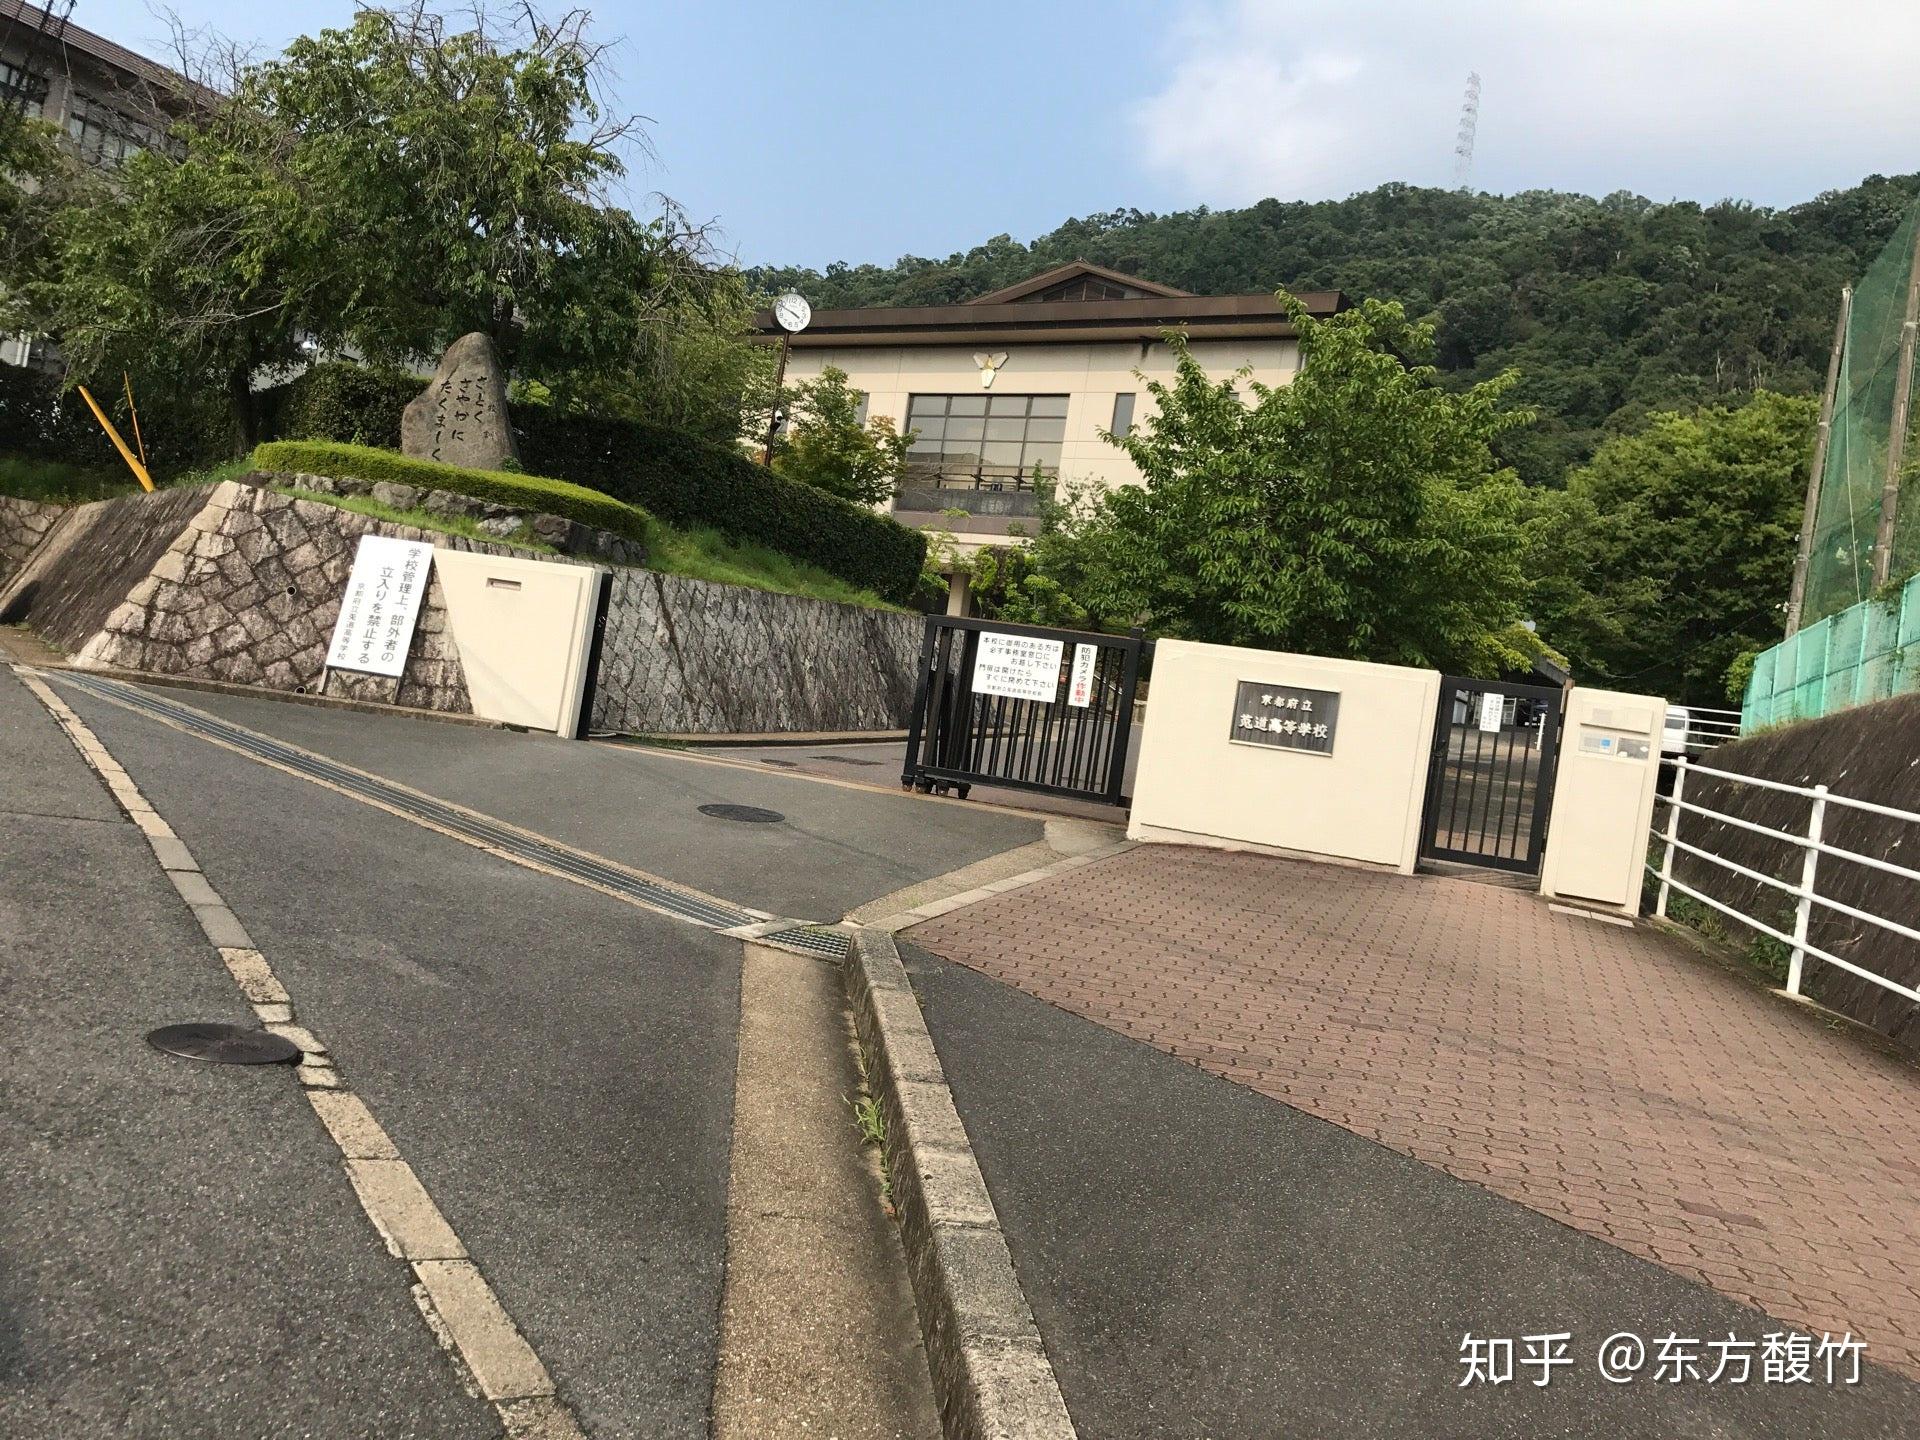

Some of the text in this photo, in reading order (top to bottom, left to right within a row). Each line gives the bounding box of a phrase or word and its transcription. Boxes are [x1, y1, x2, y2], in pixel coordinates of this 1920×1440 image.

[431, 380, 452, 461] たくましく
[451, 377, 472, 441] さやかに
[474, 375, 488, 424] さとく
[358, 565, 395, 664] 立入りを禁止する
[381, 547, 422, 663] 学校管理上、部外者の
[1010, 657, 1057, 671] お越し下さい
[1074, 646, 1092, 704] 防犯カメラ作動中
[1260, 694, 1313, 712] 京都府立
